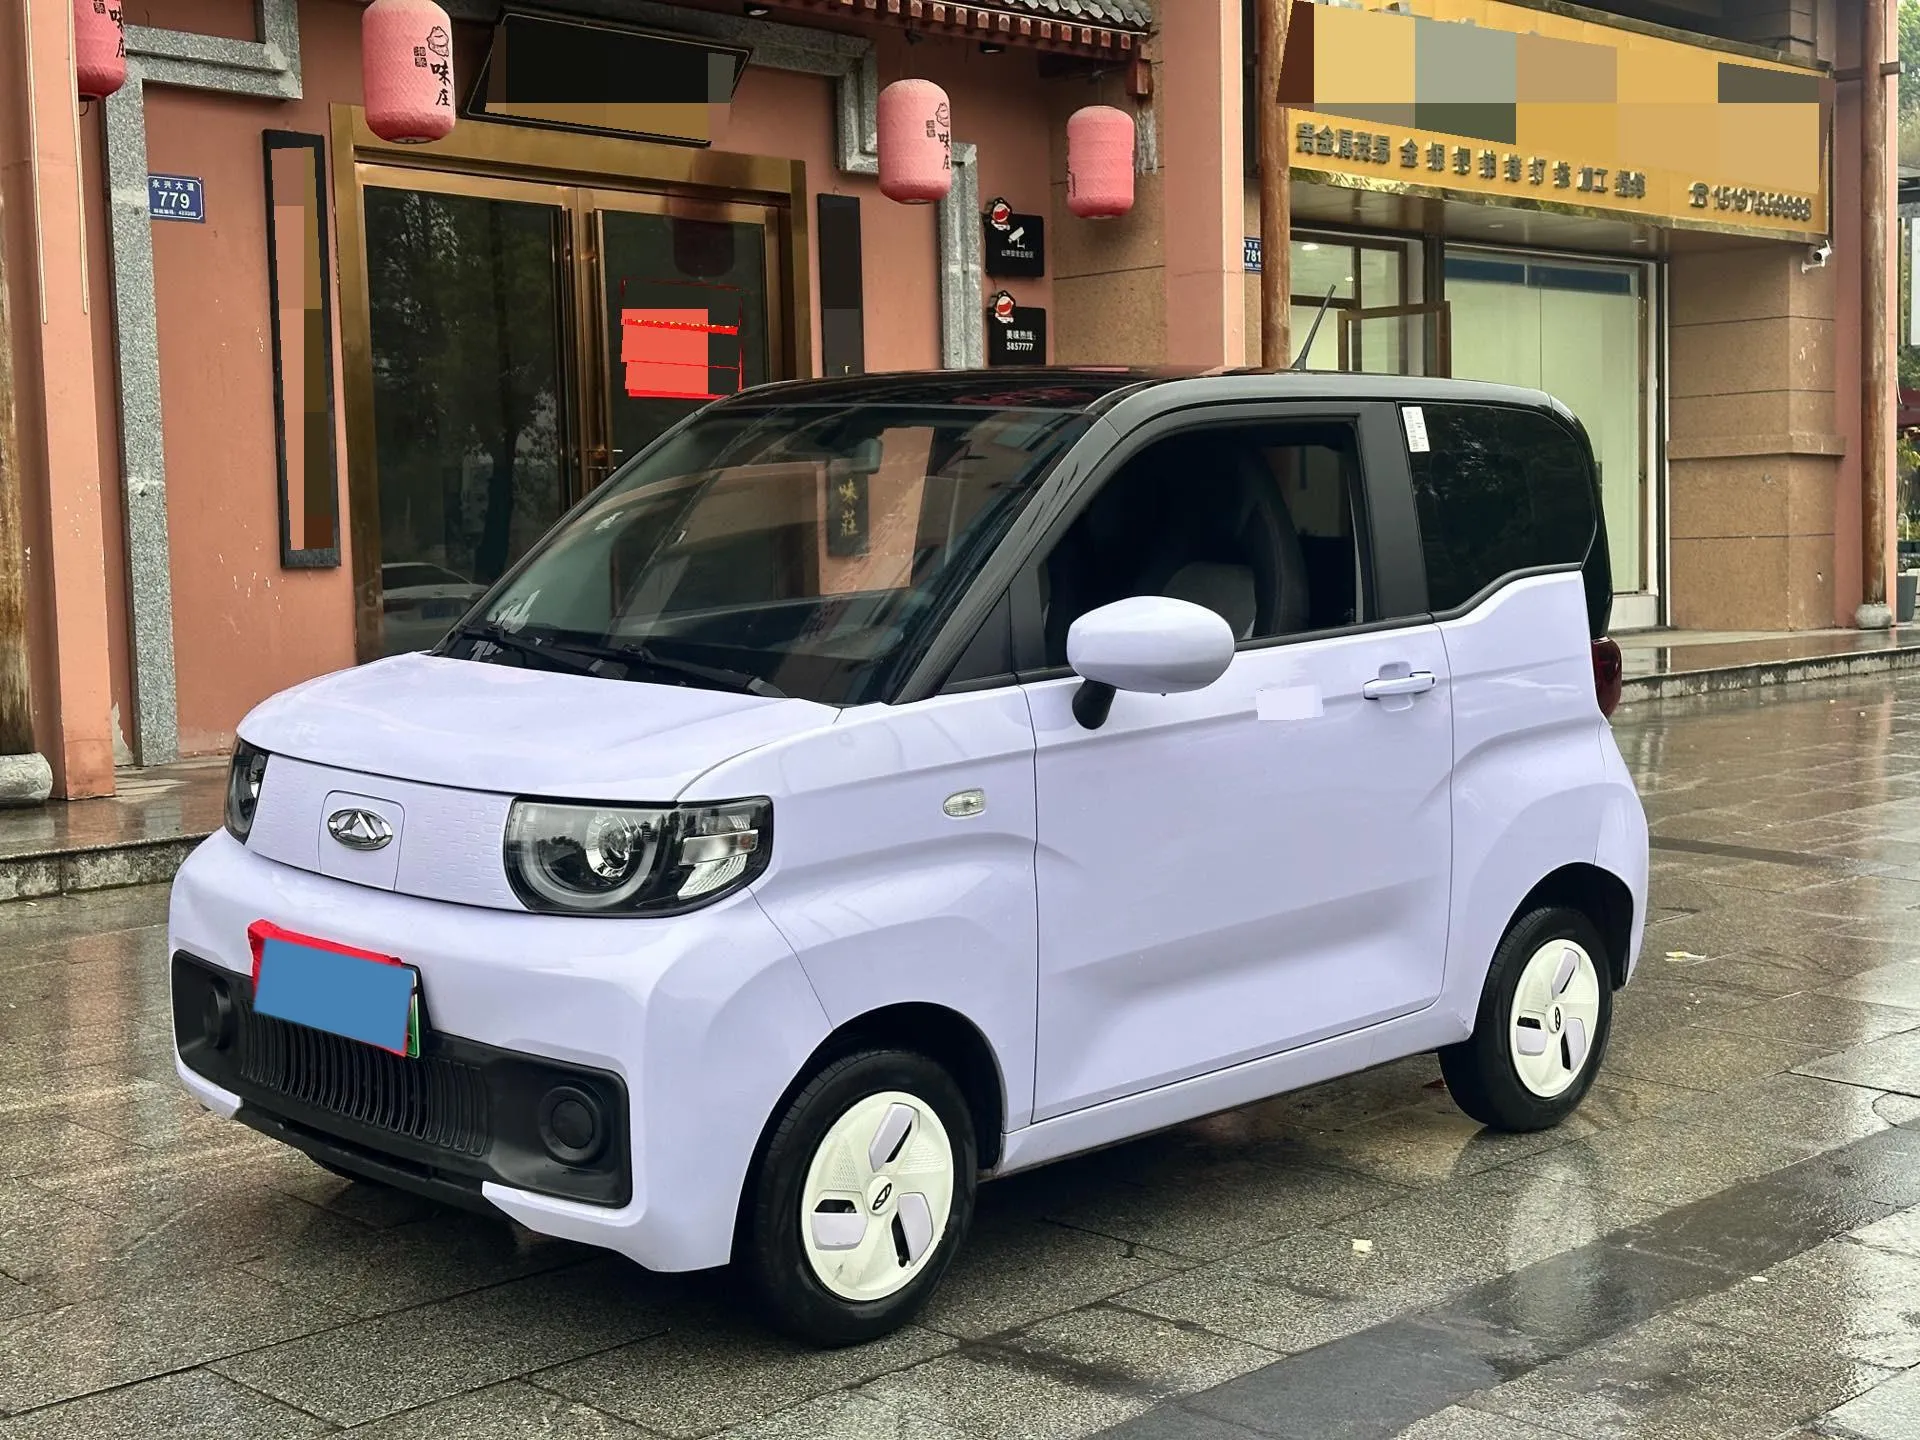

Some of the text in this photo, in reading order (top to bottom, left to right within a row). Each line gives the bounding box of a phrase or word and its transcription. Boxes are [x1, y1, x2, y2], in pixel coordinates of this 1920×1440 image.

[430, 60, 451, 106] 味庄
[152, 179, 195, 191] 永兴大道
[158, 191, 190, 209] 779
[1006, 341, 1034, 351] 5857777
